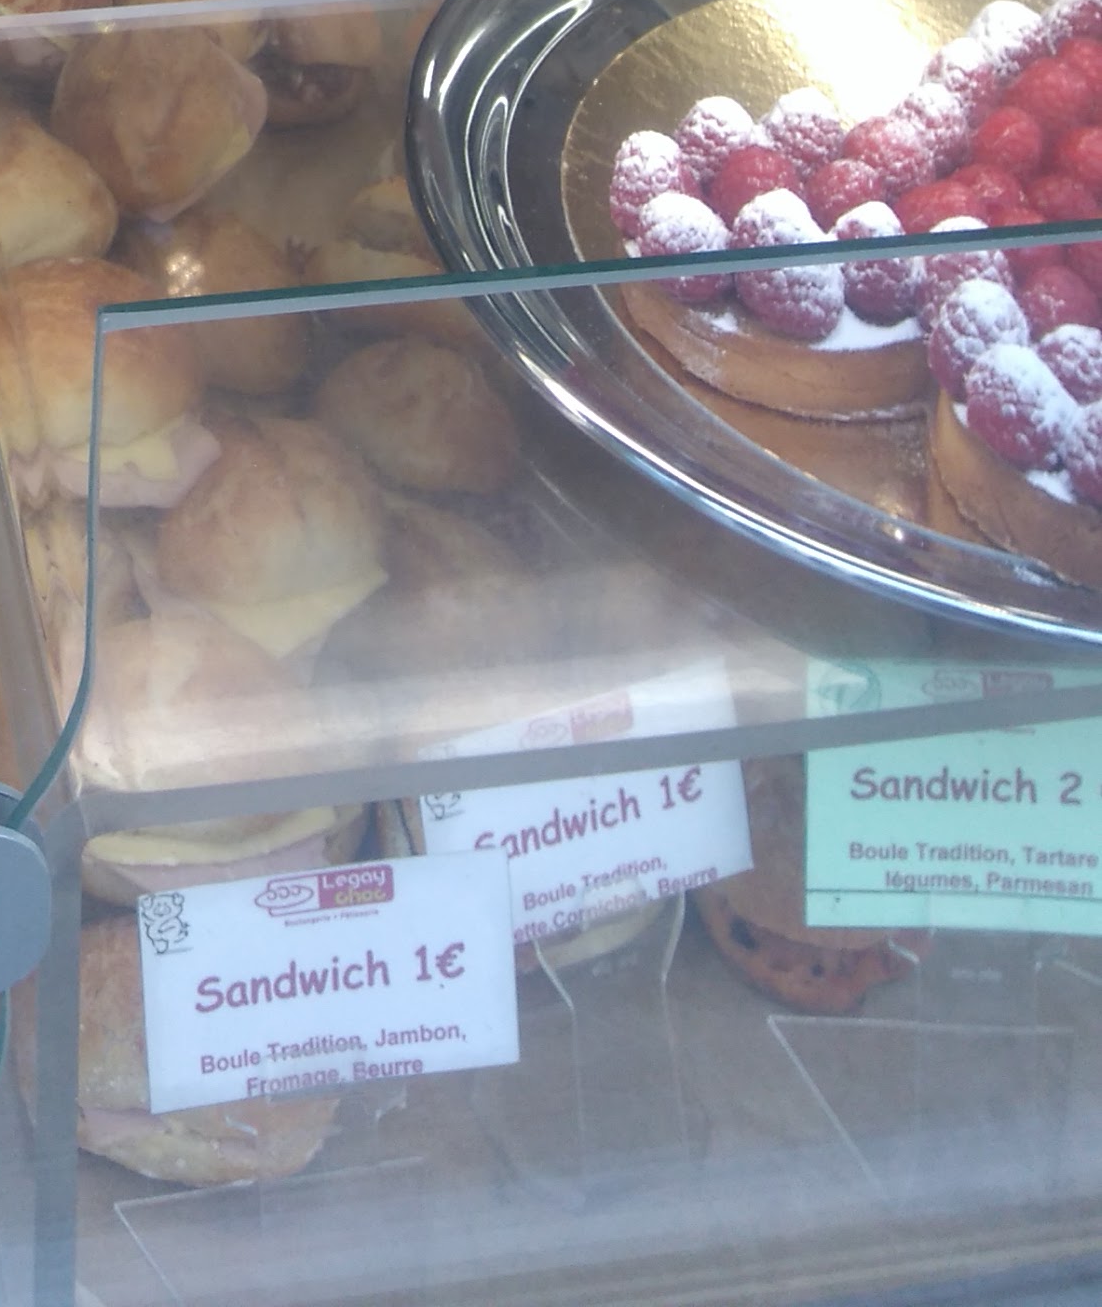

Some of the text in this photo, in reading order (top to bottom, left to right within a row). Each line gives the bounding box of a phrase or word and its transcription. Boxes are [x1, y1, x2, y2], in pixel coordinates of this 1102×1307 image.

[660, 767, 703, 810] 1€
[850, 765, 1082, 805] Sandwich 2
[849, 842, 1099, 868] Boule Tradition, Tartare
[322, 869, 386, 890] Legay
[987, 872, 1094, 896] Parmesan
[335, 888, 387, 904] choc
[523, 883, 576, 911] Boule
[194, 942, 466, 1013] Sandwich 1€
[200, 1024, 467, 1075] Boule Tradition, Jambon,
[352, 1058, 424, 1082] Beurre
